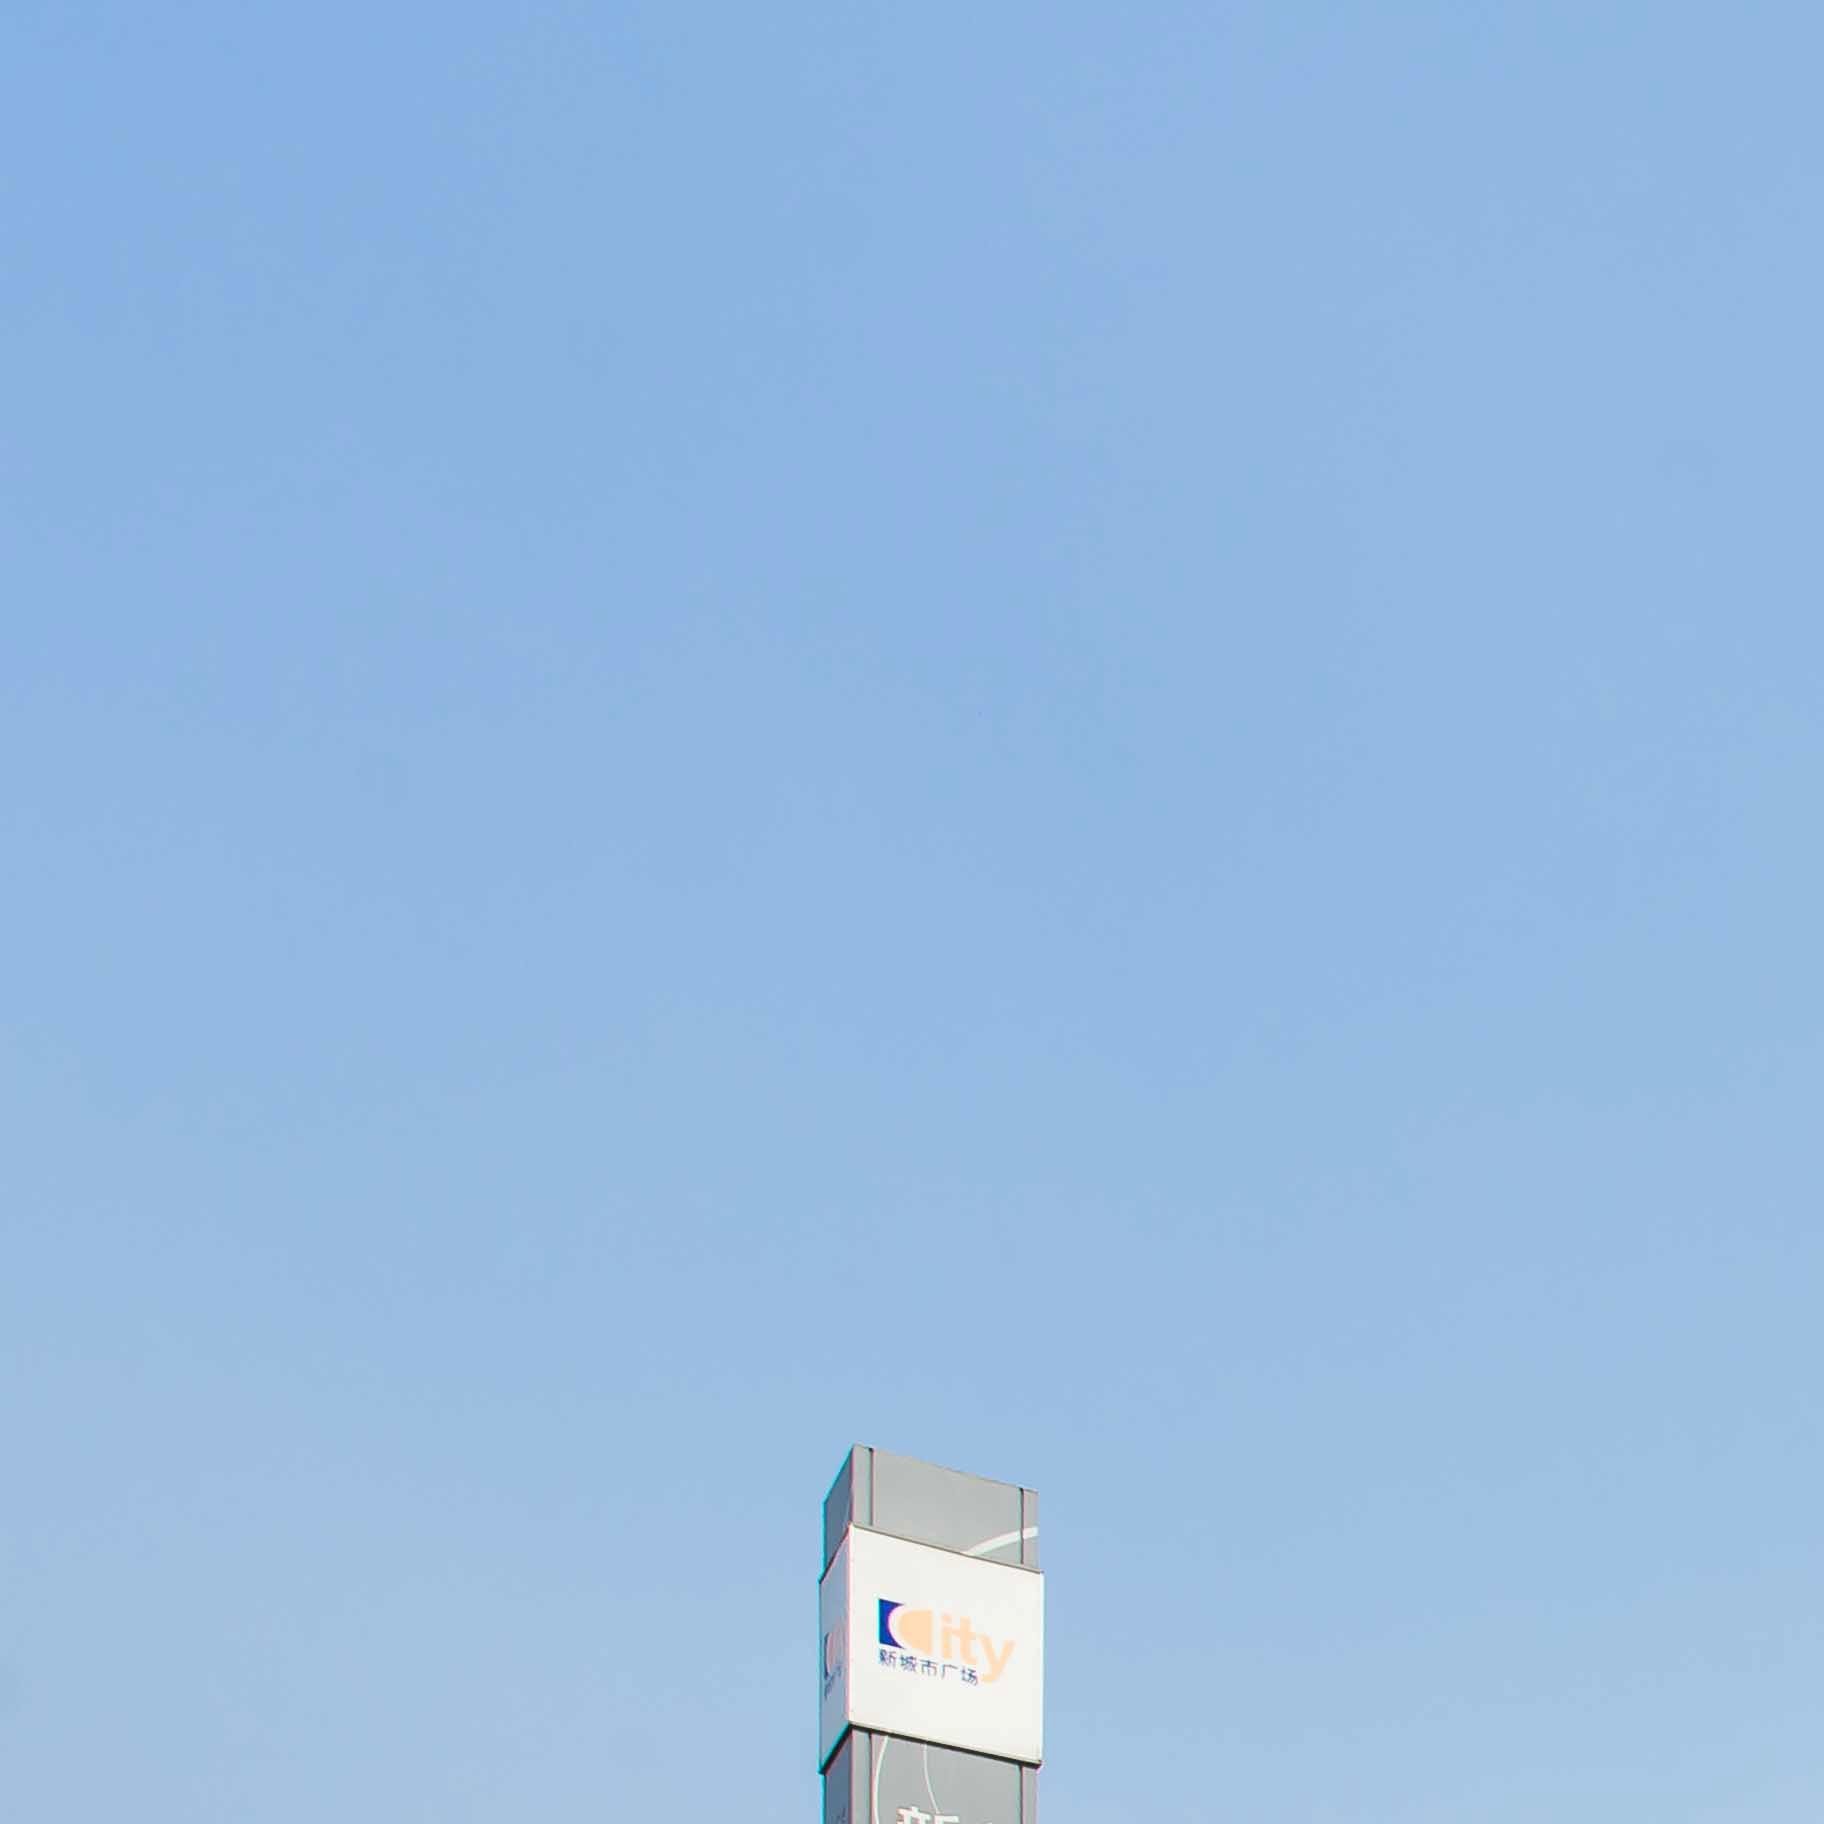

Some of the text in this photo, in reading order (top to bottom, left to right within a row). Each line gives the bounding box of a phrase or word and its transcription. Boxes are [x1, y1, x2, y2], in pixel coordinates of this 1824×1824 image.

[879, 1648, 979, 1686] 新城市广场
